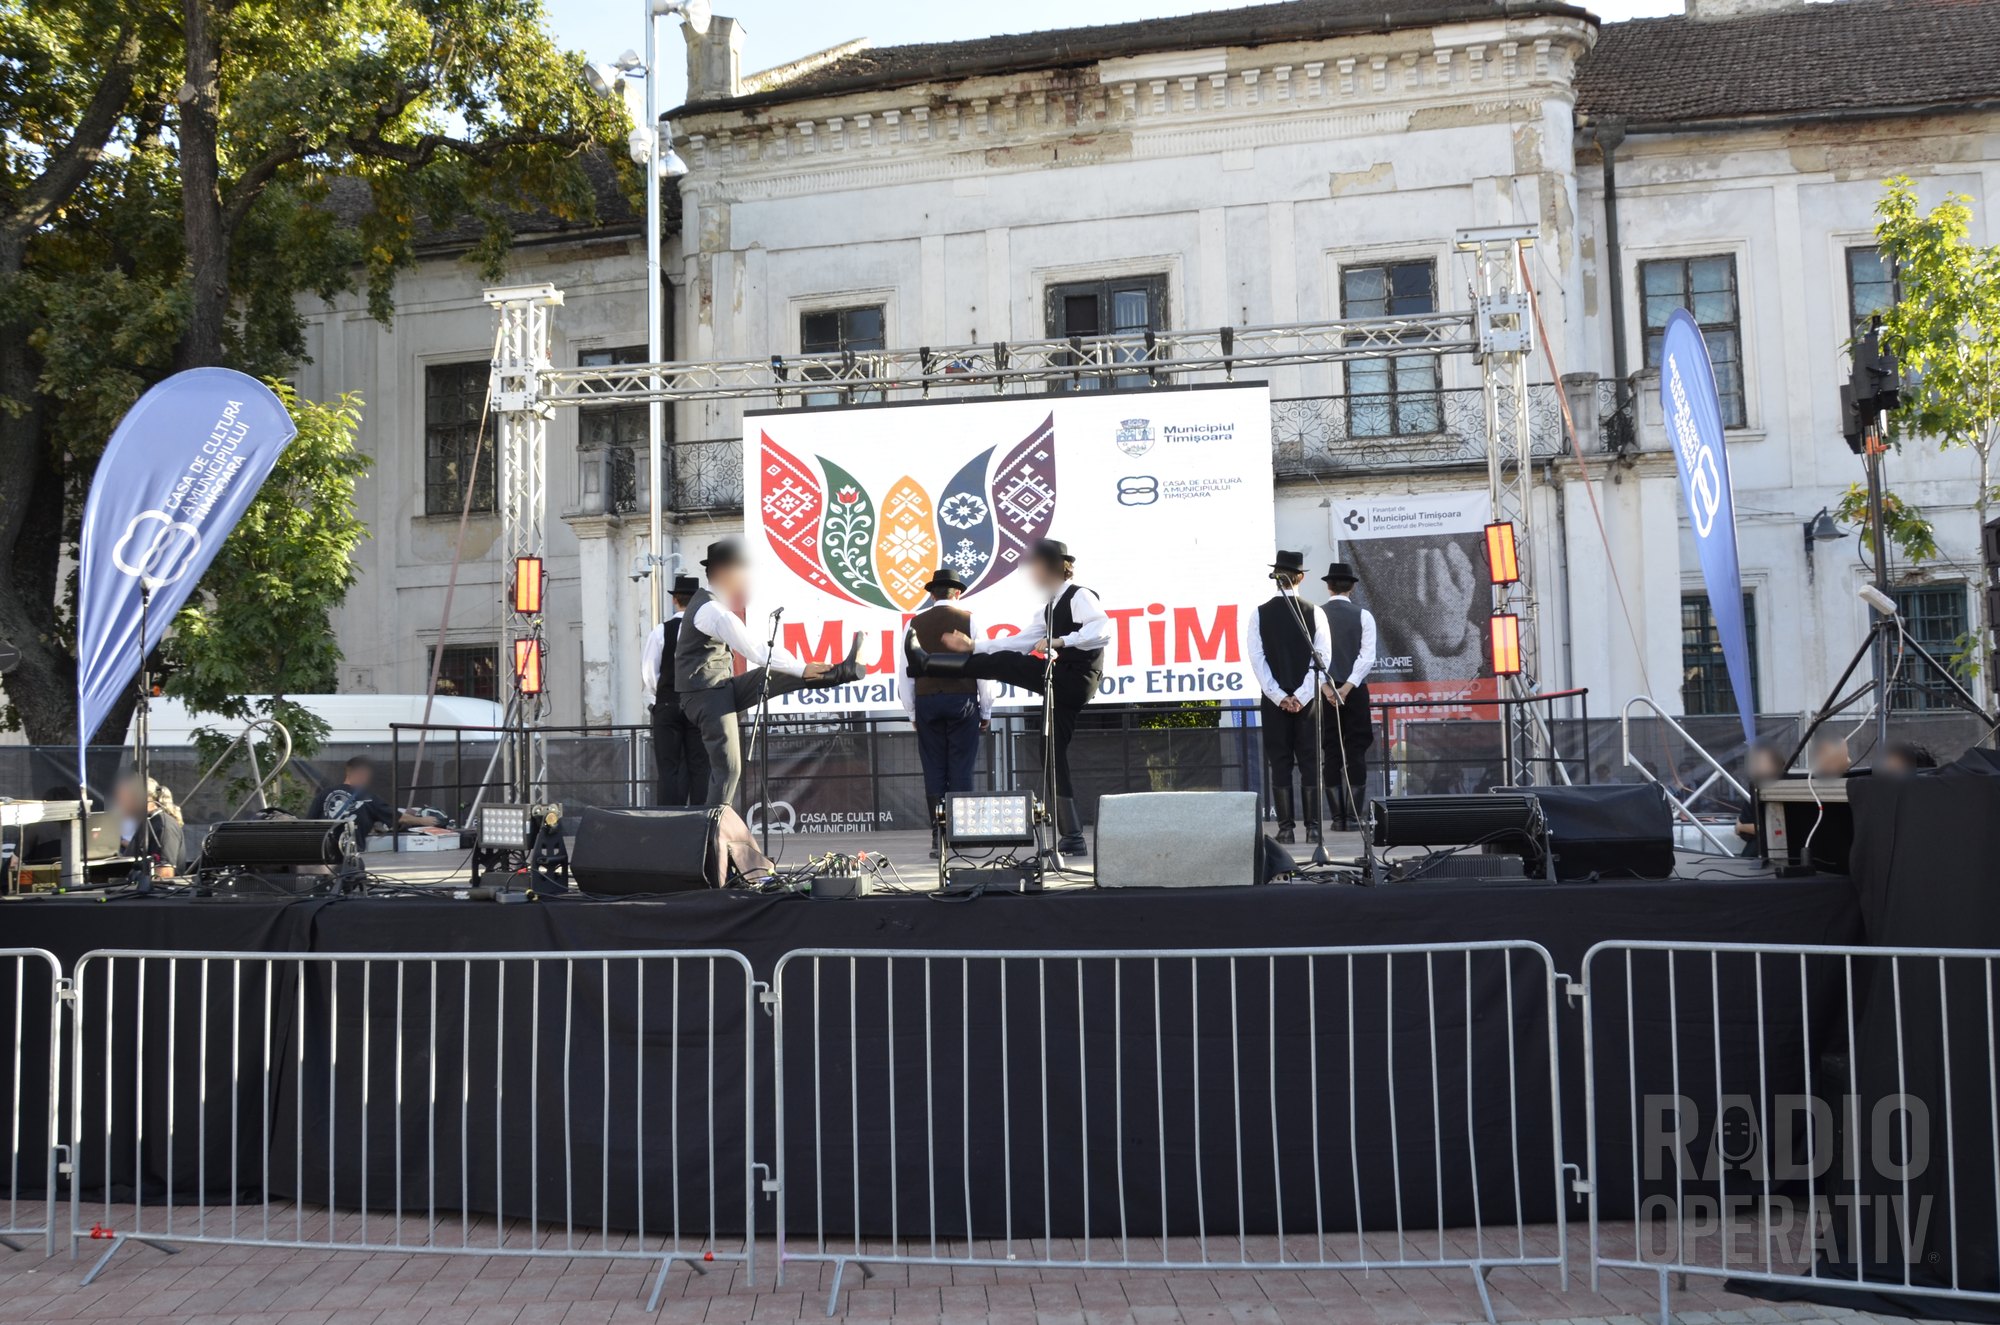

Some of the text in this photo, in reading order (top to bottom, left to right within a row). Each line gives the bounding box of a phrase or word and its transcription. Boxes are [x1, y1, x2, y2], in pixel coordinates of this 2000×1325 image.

[1164, 423, 1235, 434] Municipiul
[181, 421, 250, 516] A MUNICIPIULUI
[166, 475, 196, 509] CASA
[189, 455, 209, 474] DE
[1171, 485, 1231, 493] MUNICIPIULUI
[1373, 512, 1417, 522] Municipiul
[1146, 668, 1243, 694] Etnice
[800, 813, 828, 823] CASA
[831, 813, 844, 822] DE
[800, 824, 808, 834] A
